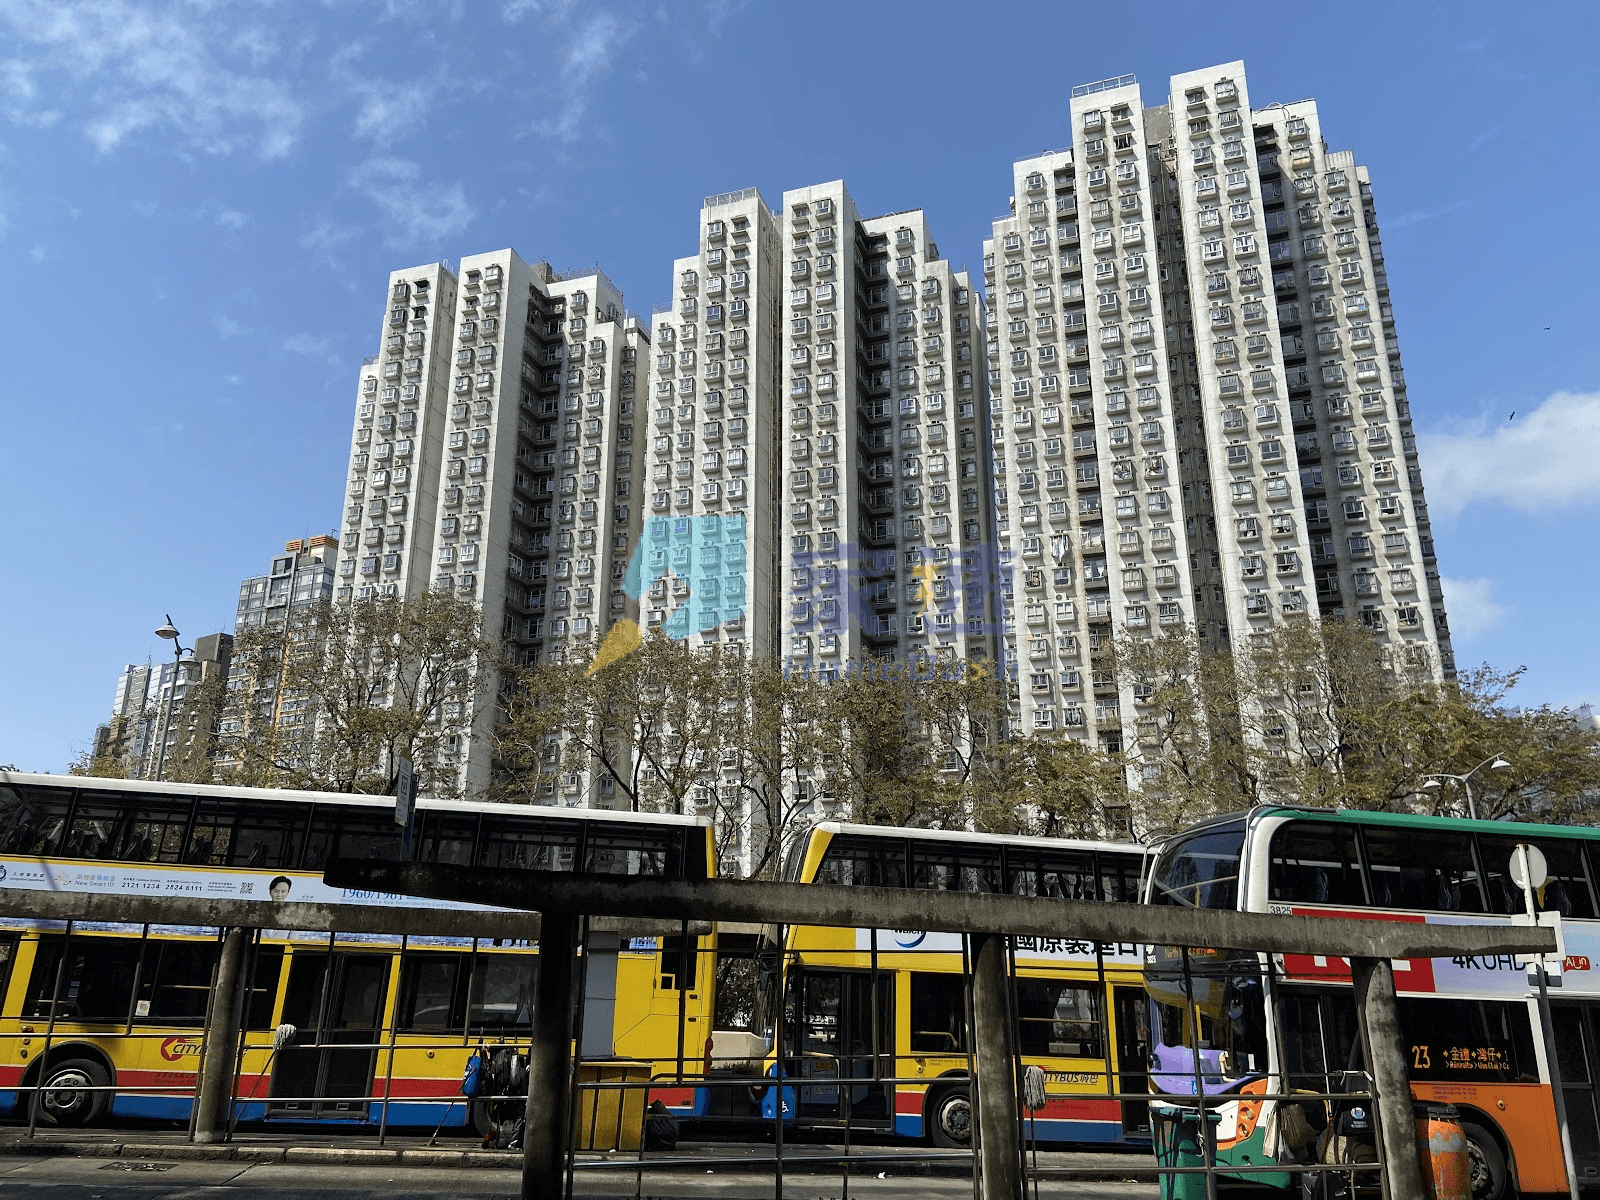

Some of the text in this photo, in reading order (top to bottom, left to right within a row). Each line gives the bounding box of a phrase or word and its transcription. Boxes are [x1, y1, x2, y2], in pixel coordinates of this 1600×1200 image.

[121, 881, 139, 889] 2121
[1270, 905, 1292, 915] 3825
[1411, 1045, 1431, 1069] 23
[1044, 1072, 1079, 1083] ITYBUS
